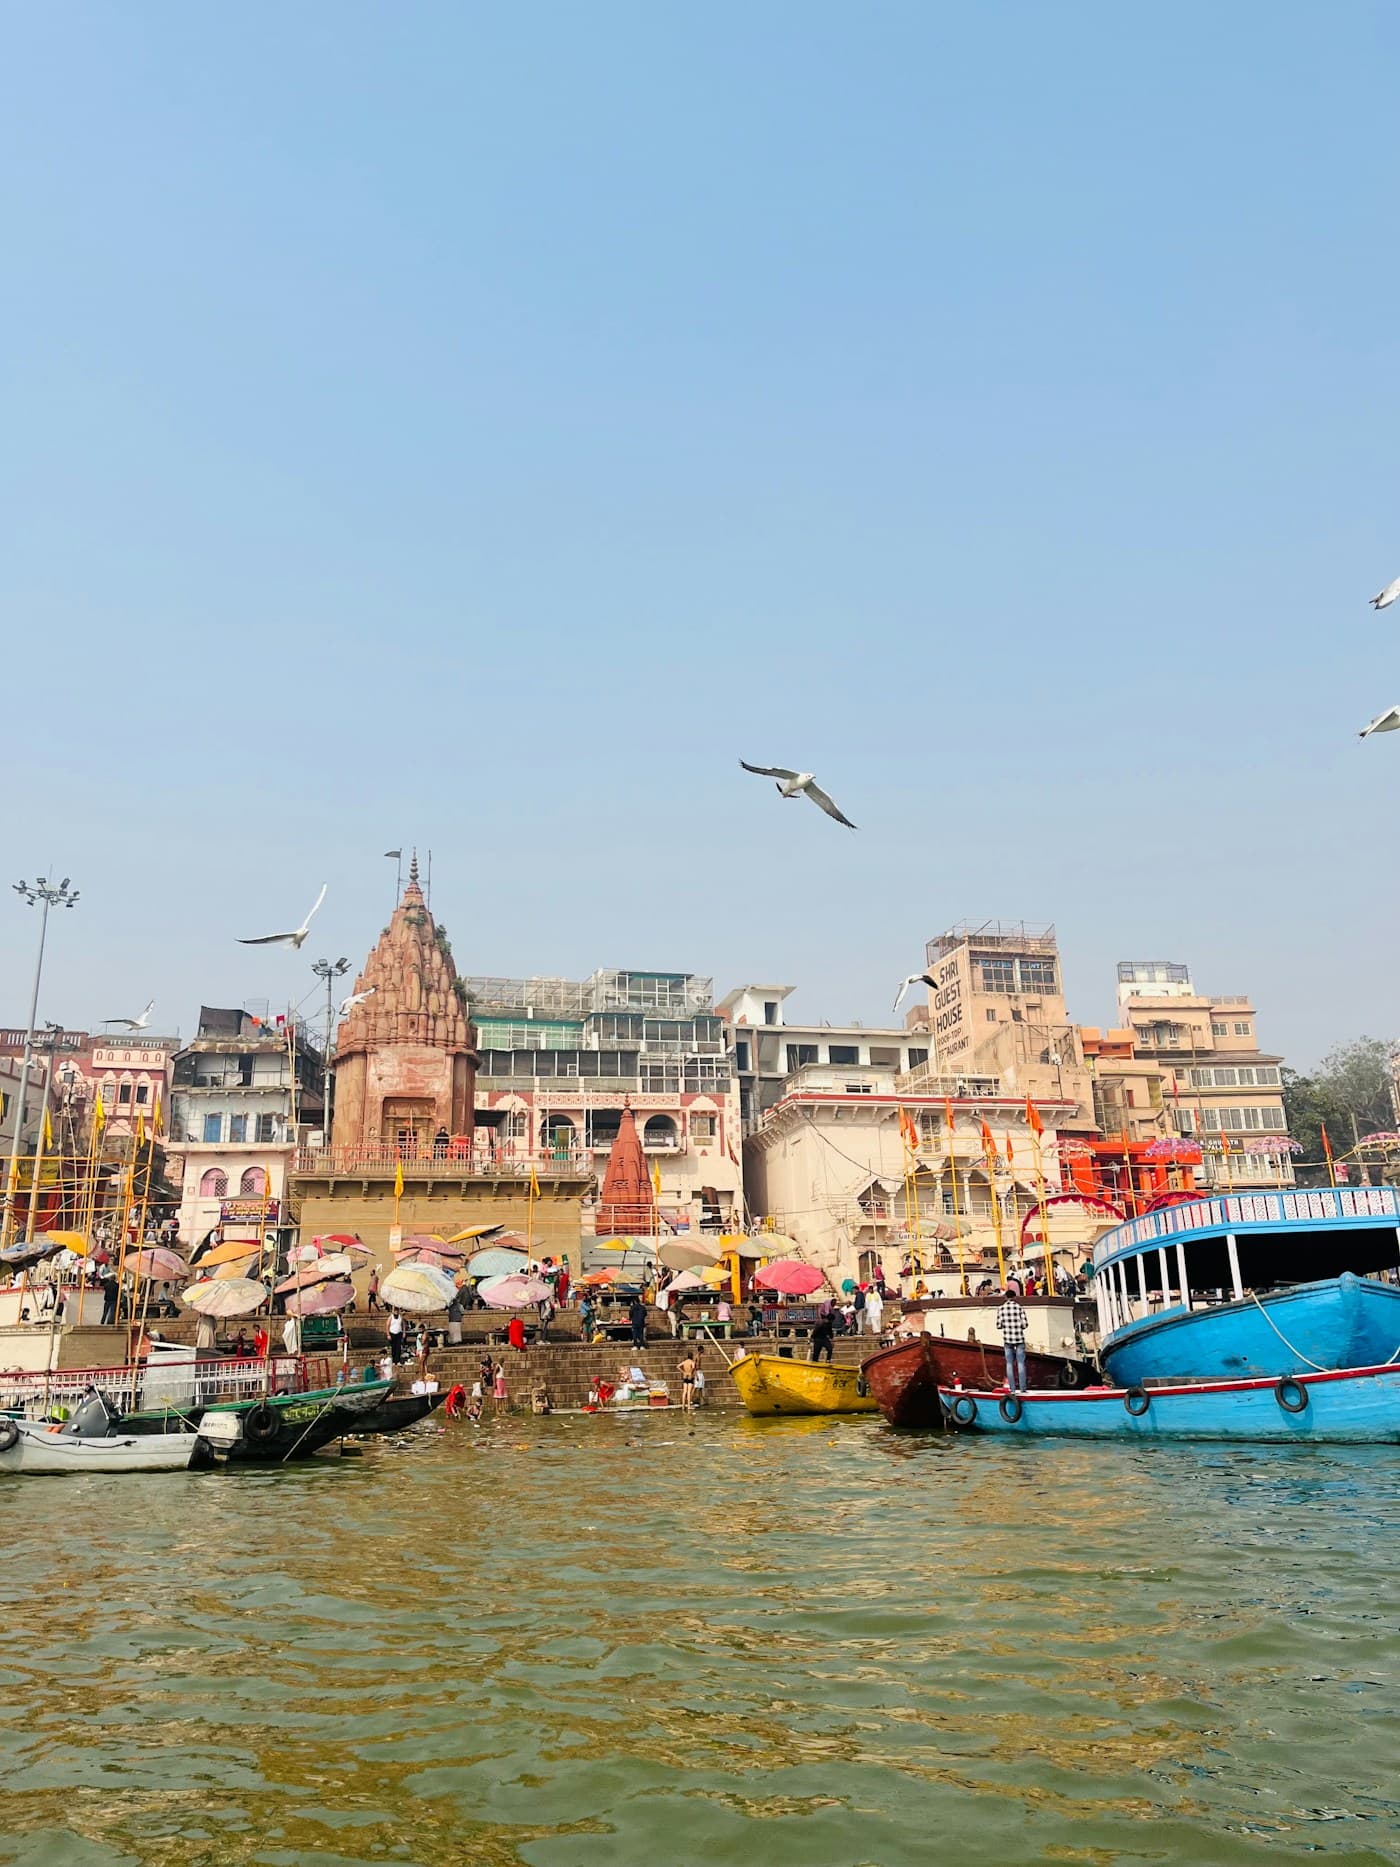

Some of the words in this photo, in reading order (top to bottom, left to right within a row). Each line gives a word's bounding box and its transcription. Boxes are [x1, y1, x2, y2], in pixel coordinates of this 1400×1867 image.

[939, 960, 959, 985] SHRI
[934, 980, 961, 1010] GUEST
[936, 1003, 962, 1034] HOUSE
[937, 1036, 969, 1059] TAURANT
